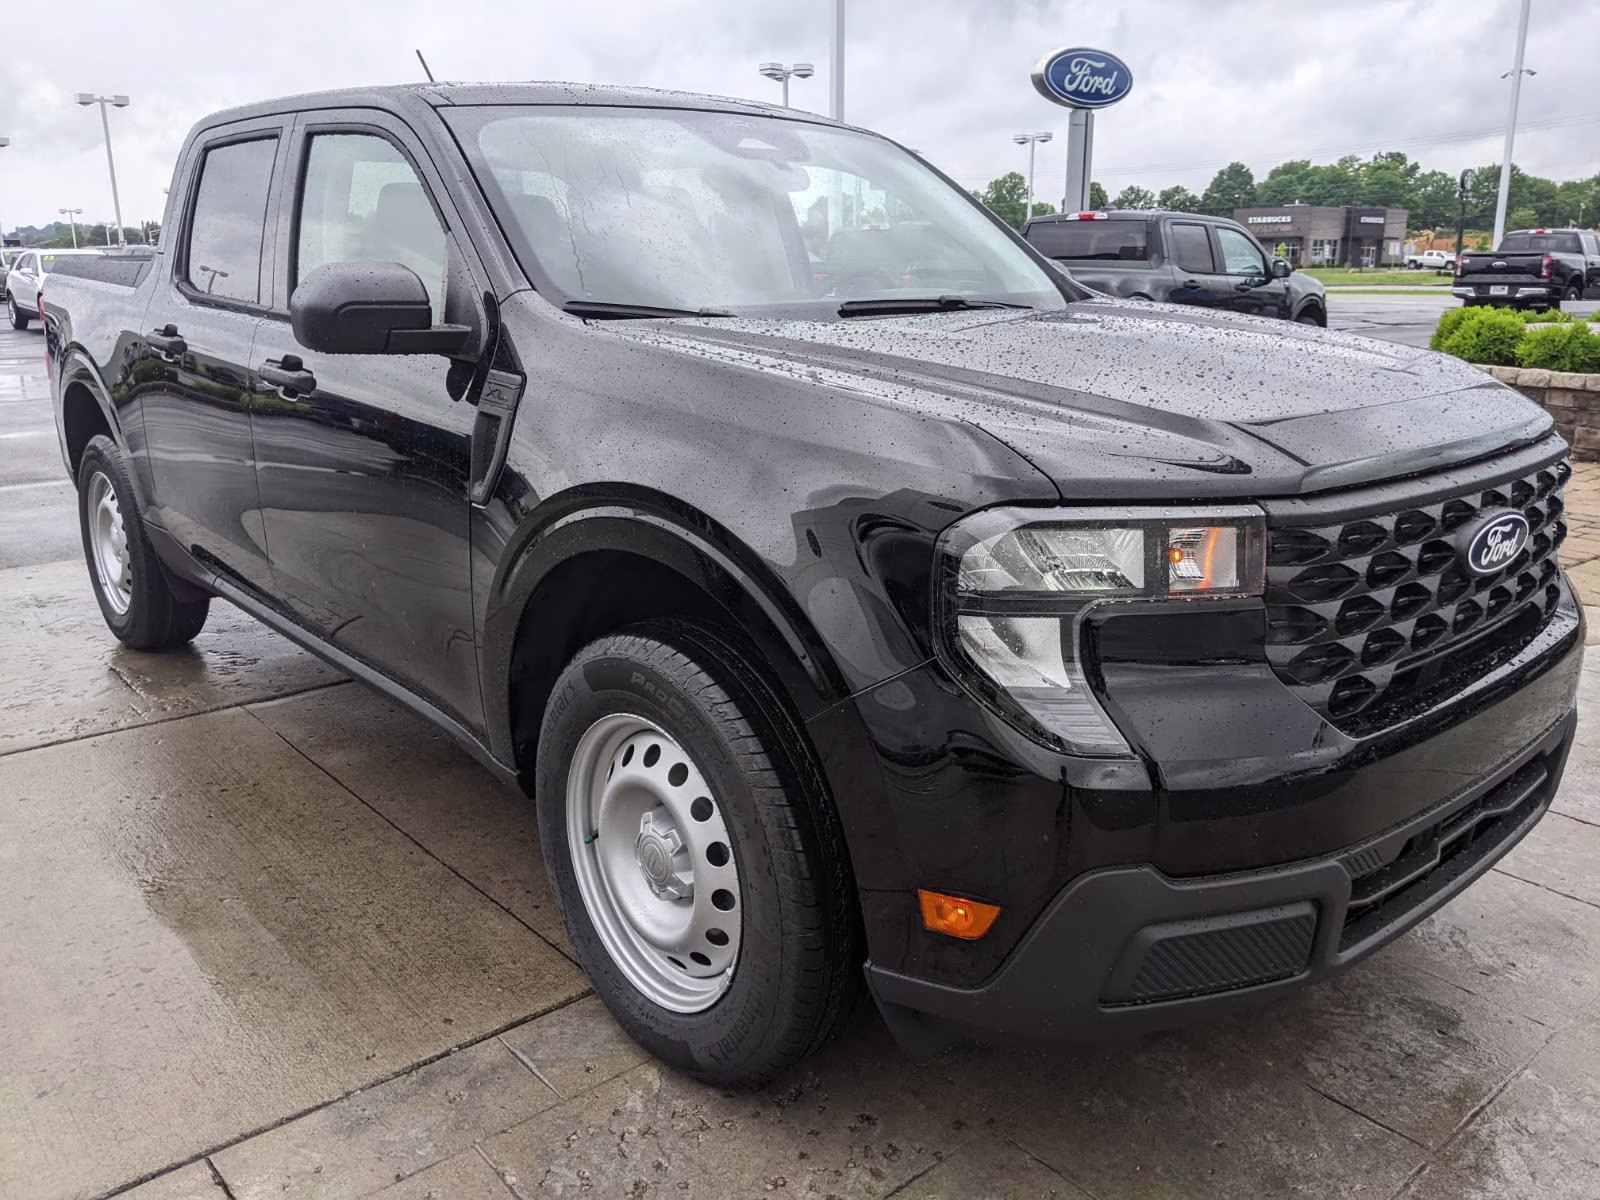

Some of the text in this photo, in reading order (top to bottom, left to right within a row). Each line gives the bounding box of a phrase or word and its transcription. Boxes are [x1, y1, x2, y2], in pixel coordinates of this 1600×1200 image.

[1064, 57, 1118, 95] Ford
[1247, 215, 1292, 224] STARBUCKS
[485, 385, 508, 402] XL
[1480, 523, 1520, 566] Ford
